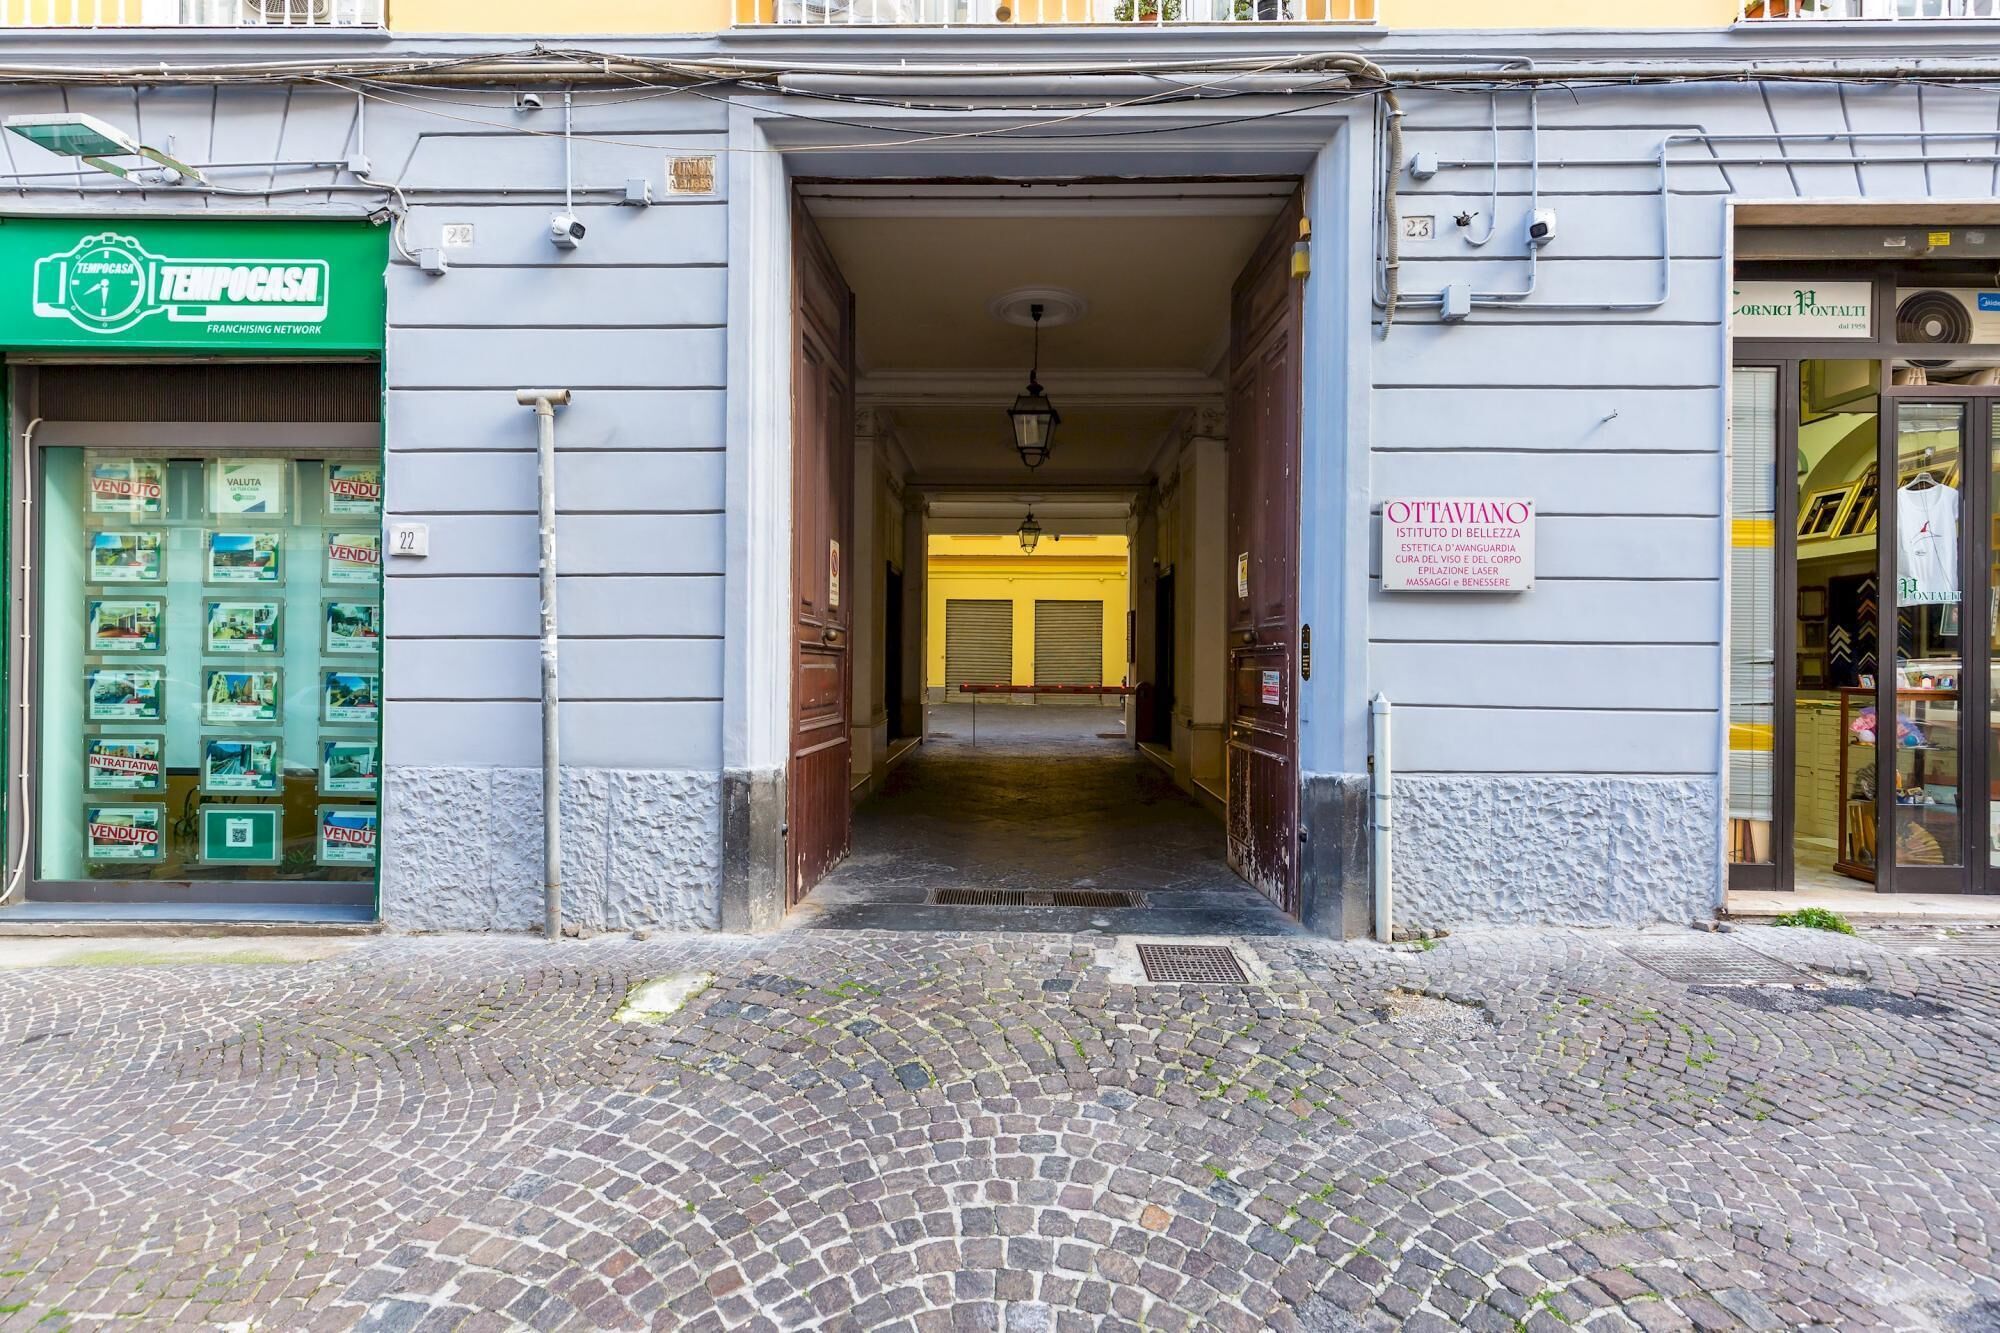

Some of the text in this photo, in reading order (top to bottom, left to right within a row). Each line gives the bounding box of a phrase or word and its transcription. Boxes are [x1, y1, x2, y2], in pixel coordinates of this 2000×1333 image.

[448, 227, 471, 243] 22
[1407, 220, 1429, 237] 23
[77, 263, 134, 274] TEMPOCASA
[159, 266, 319, 302] TEMPOCASA
[1793, 290, 1866, 316] PONTALTI
[206, 325, 322, 335] FRANCHISING NETWORK
[92, 479, 160, 497] VENDUTO
[226, 478, 261, 486] VALUTA
[330, 480, 380, 497] VENDU
[1387, 501, 1529, 524] OTTAVIANO
[400, 531, 414, 549] 22
[1396, 527, 1521, 538] ISTITUTO DI BELLEZZA
[329, 546, 380, 563] VENDU
[1401, 544, 1516, 552] ESTETICA D'AVANGUARDIA
[1395, 555, 1419, 563] CURA
[1422, 555, 1438, 563] DEL
[1441, 555, 1461, 563] VISO
[1472, 556, 1488, 564] DEL
[1491, 556, 1521, 564] CORPO
[1418, 566, 1499, 575] EPILAZIONE LASER
[1406, 578, 1450, 587] MASSAGGI
[1462, 578, 1510, 587] BENESSERE
[90, 756, 159, 771] IN TRATTATIVA
[90, 824, 158, 842] VENDUTO
